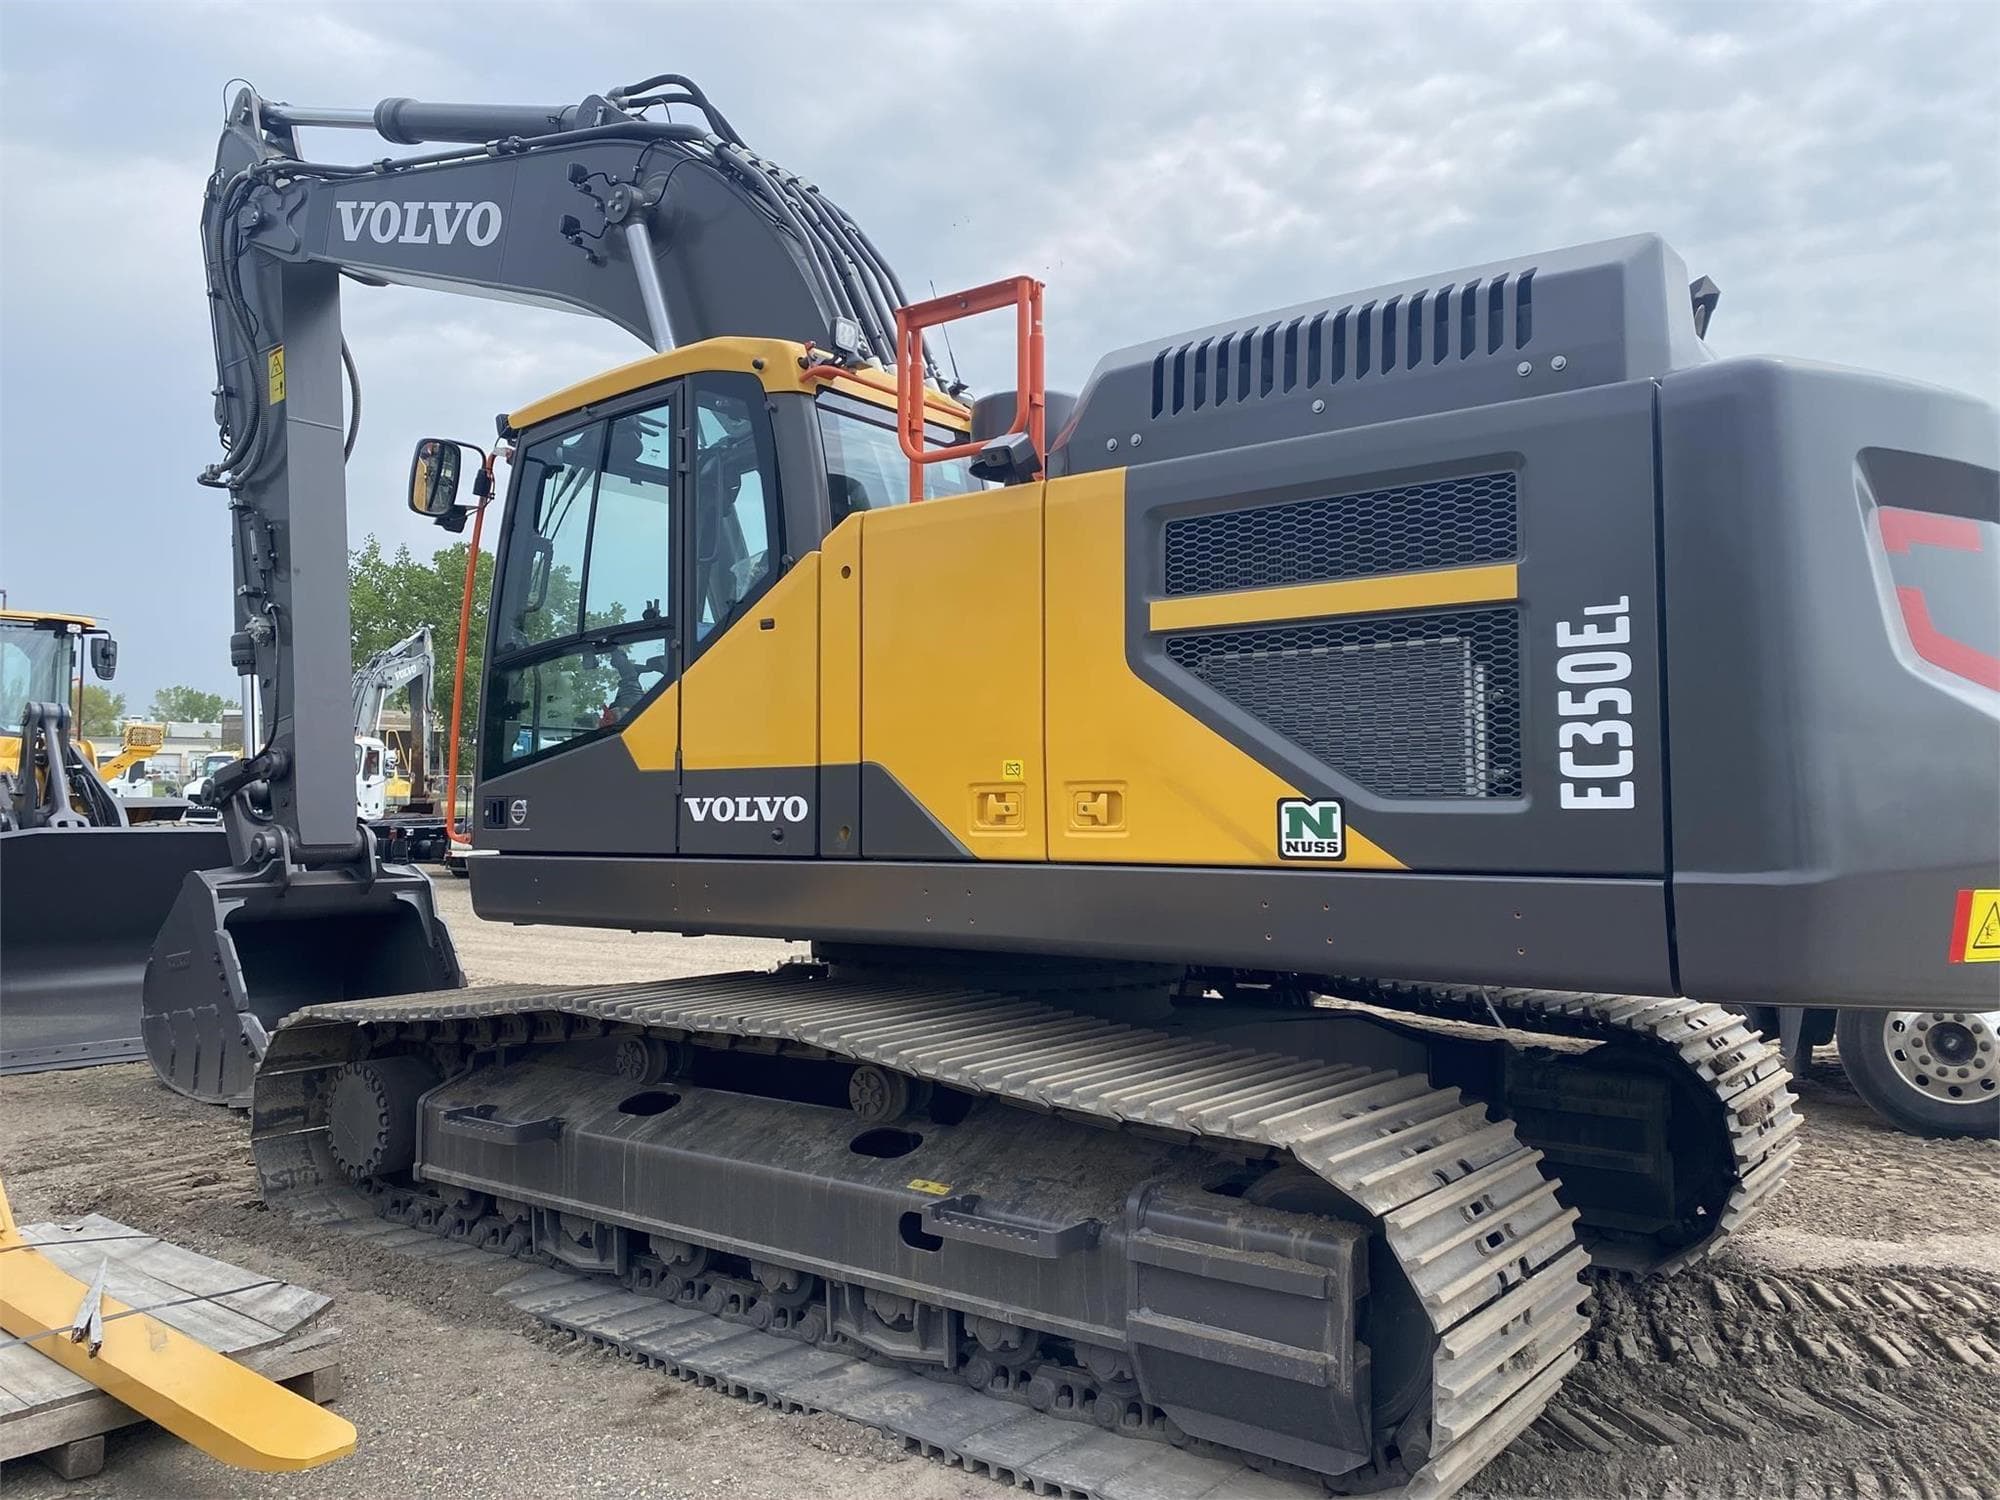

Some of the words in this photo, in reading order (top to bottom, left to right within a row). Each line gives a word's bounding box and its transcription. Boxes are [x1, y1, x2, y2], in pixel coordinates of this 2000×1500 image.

[336, 200, 502, 247] VOLVO
[394, 664, 417, 681] VOLVO
[683, 796, 808, 822] VOLVO
[1285, 806, 1338, 839] N
[1285, 841, 1338, 853] NUSS
